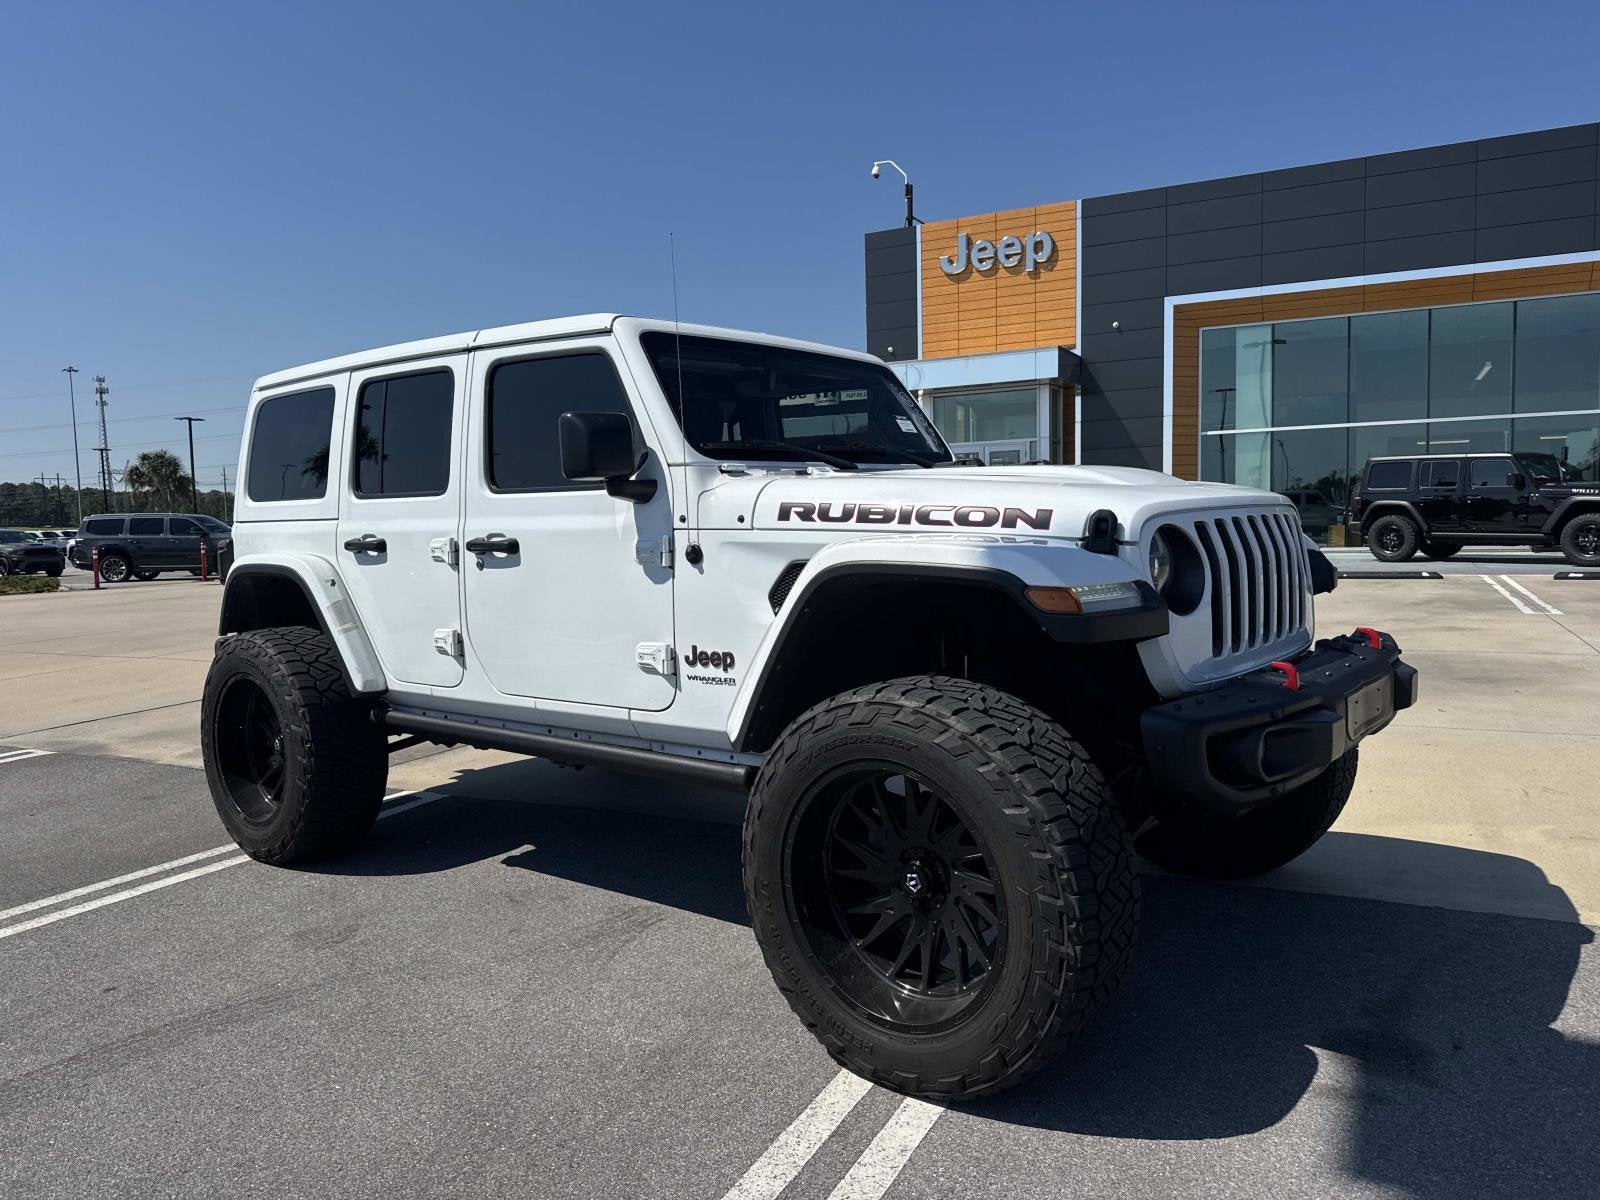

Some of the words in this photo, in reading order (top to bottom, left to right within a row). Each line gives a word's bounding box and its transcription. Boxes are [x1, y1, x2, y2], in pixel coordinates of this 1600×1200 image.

[939, 231, 1053, 275] Jeep
[777, 502, 1053, 530] RUBICON
[684, 645, 735, 673] Jeep
[687, 674, 736, 684] WRANGLER
